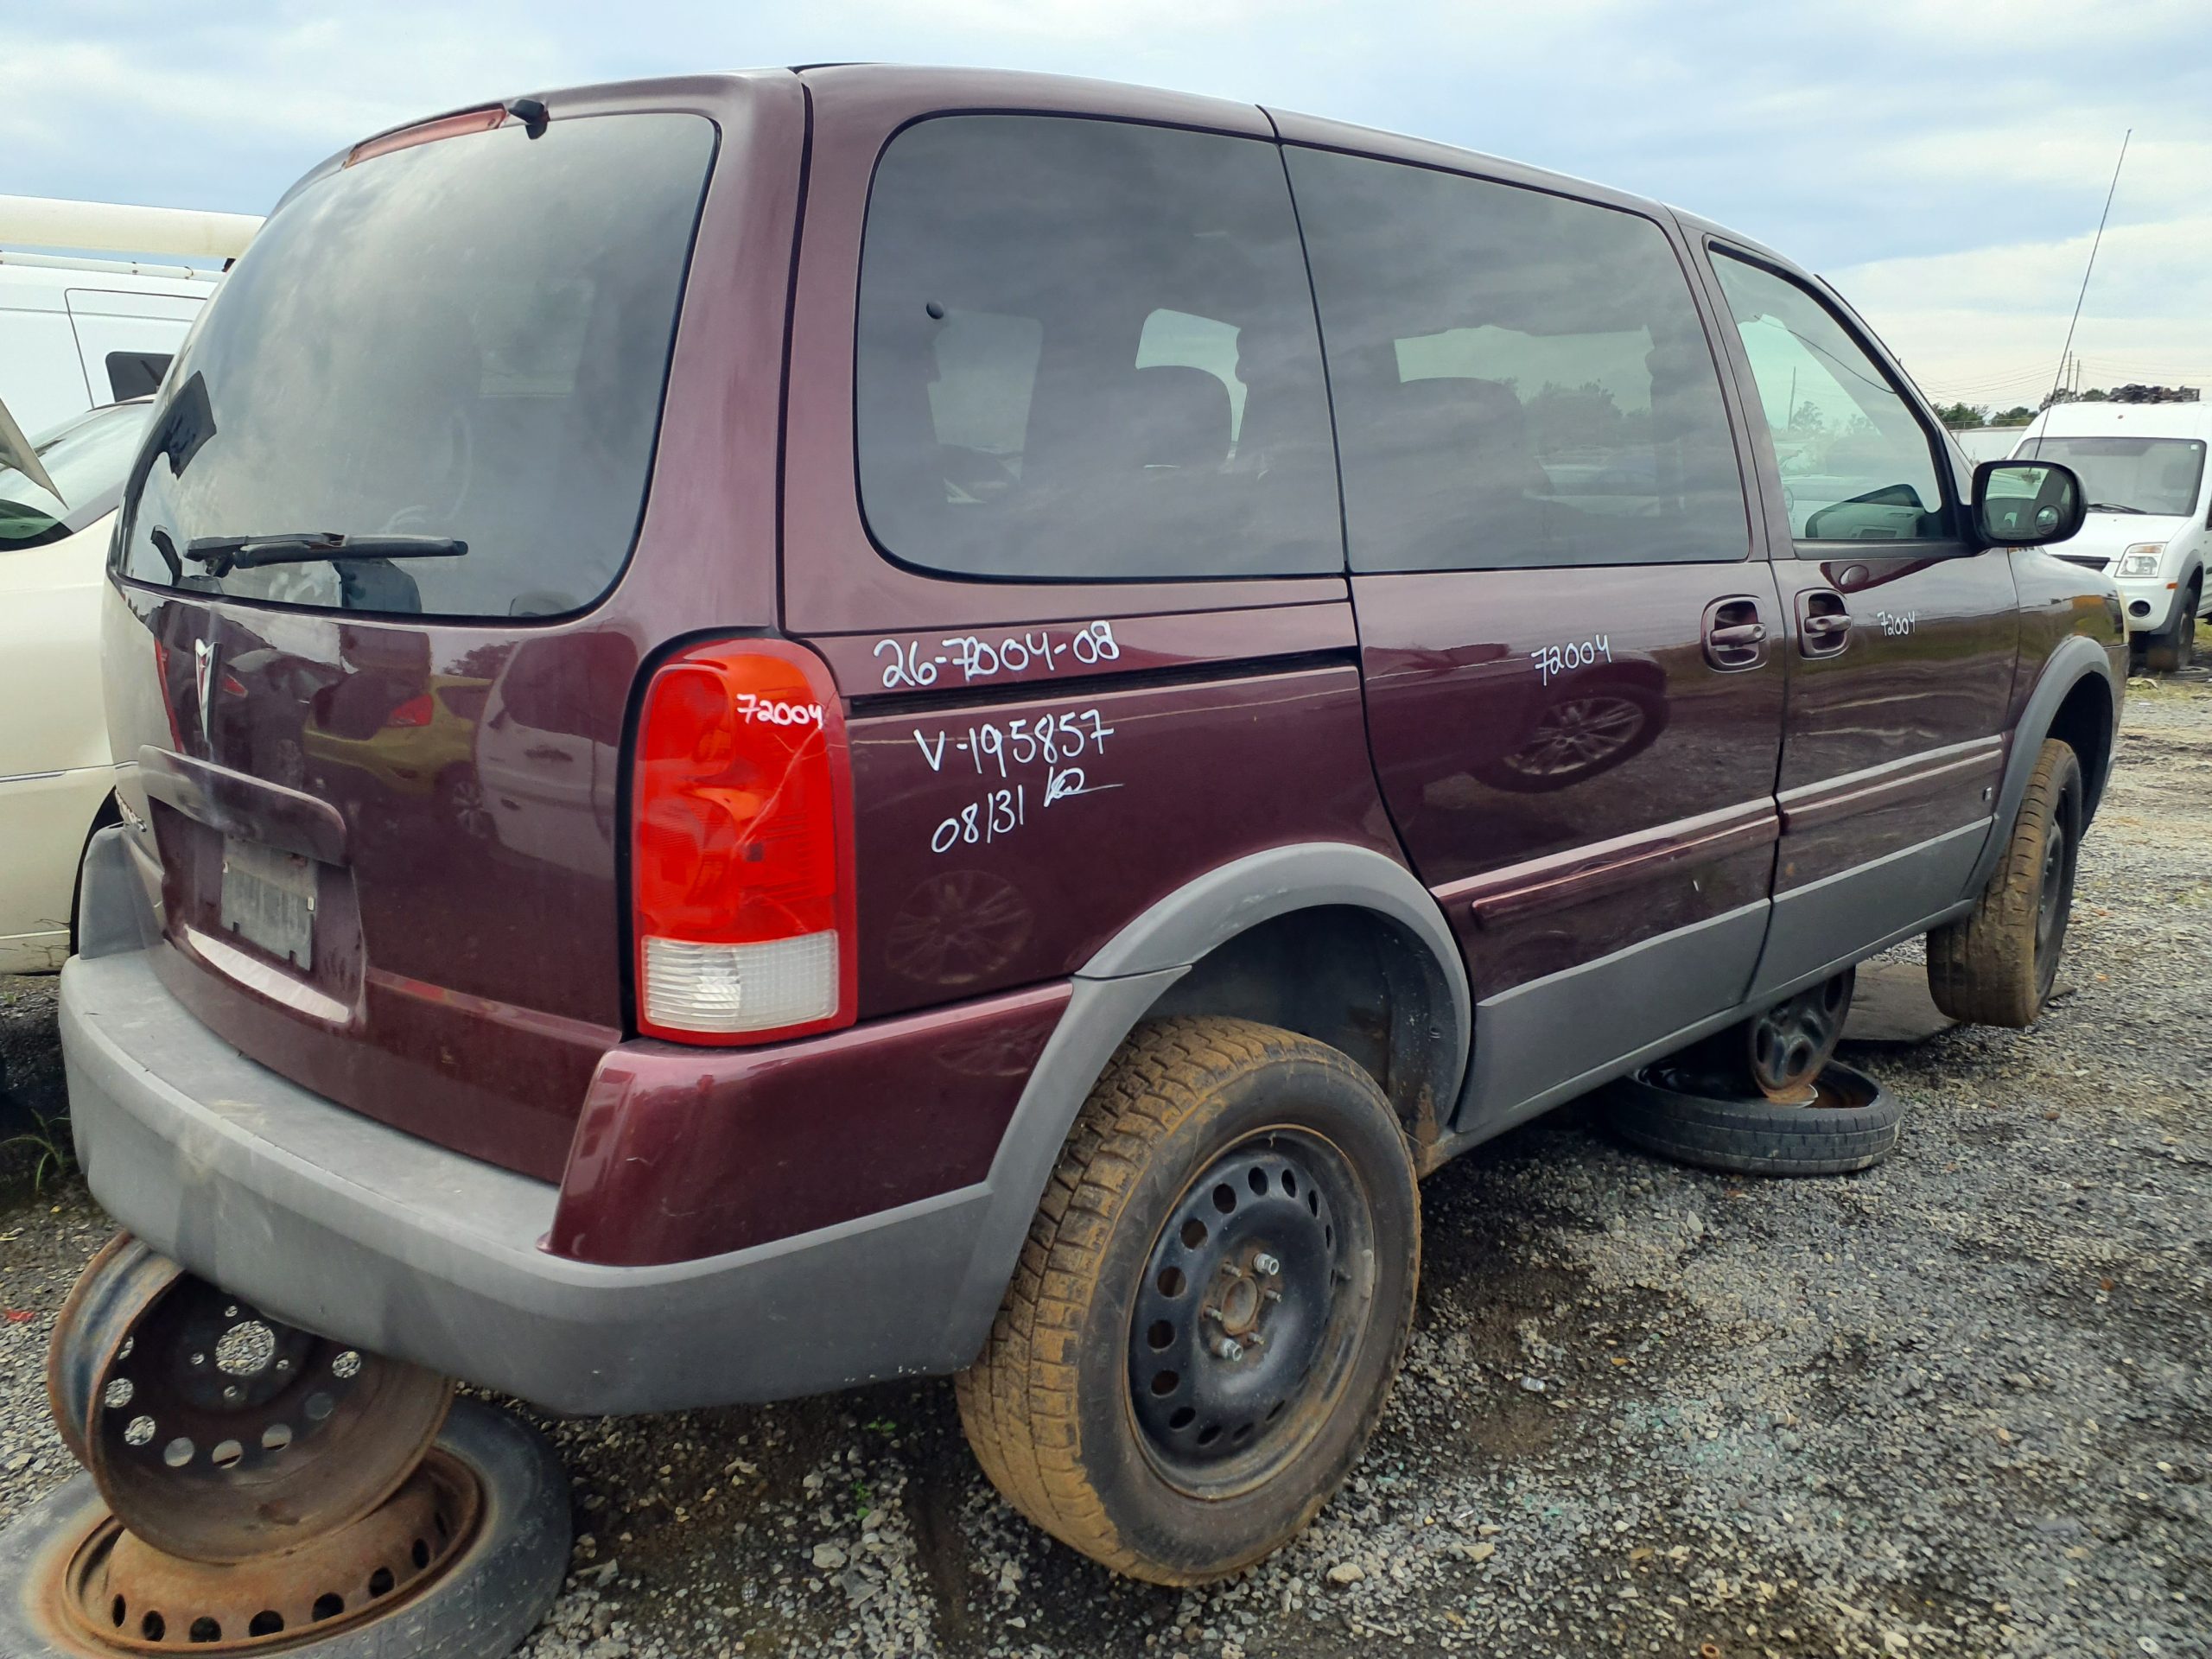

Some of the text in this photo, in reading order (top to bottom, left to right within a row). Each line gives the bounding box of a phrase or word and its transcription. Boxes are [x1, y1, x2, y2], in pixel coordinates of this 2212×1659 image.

[1877, 610, 1916, 637] 72004
[1530, 634, 1612, 686] 72004
[736, 693, 823, 730] 72004
